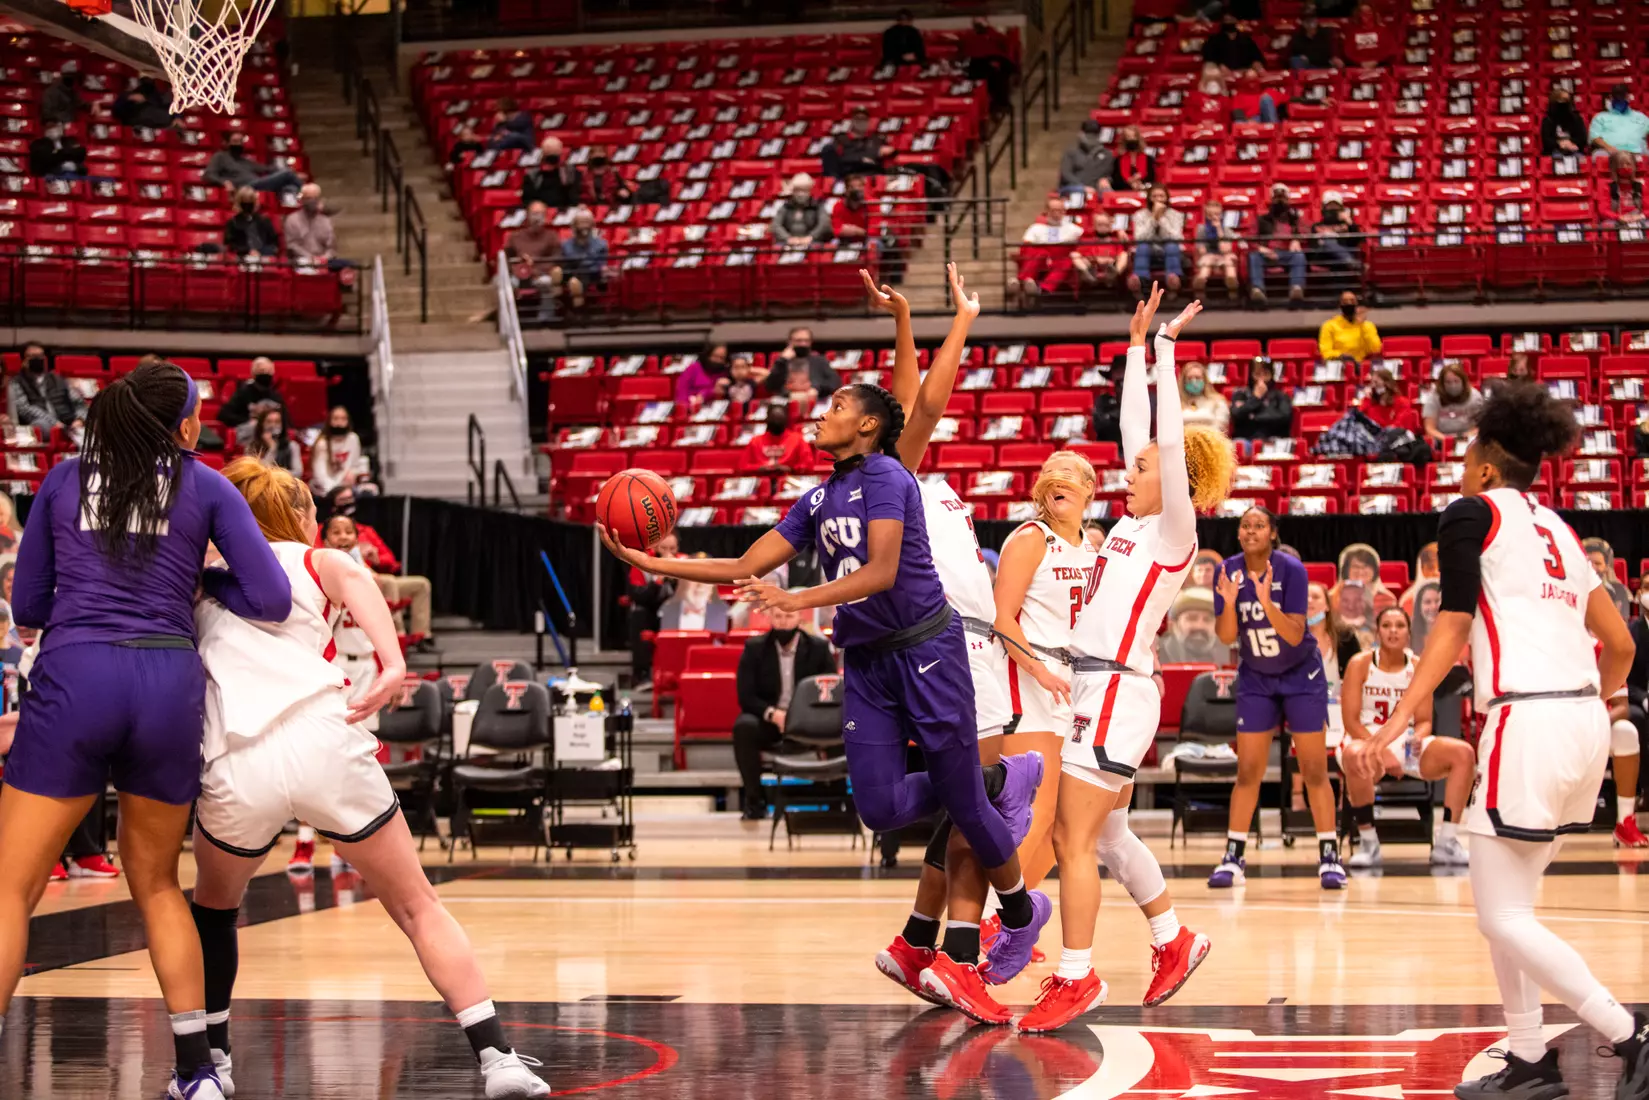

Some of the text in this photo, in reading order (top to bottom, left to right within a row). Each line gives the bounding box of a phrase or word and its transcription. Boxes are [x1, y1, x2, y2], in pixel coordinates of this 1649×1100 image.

[820, 516, 862, 558] TCU
[1106, 537, 1136, 556] TECH
[1533, 523, 1566, 581] 3
[1052, 566, 1083, 581] TEXAS
[1239, 601, 1282, 624] TC
[1246, 627, 1281, 658] 15
[1364, 685, 1392, 697] TEXAS
